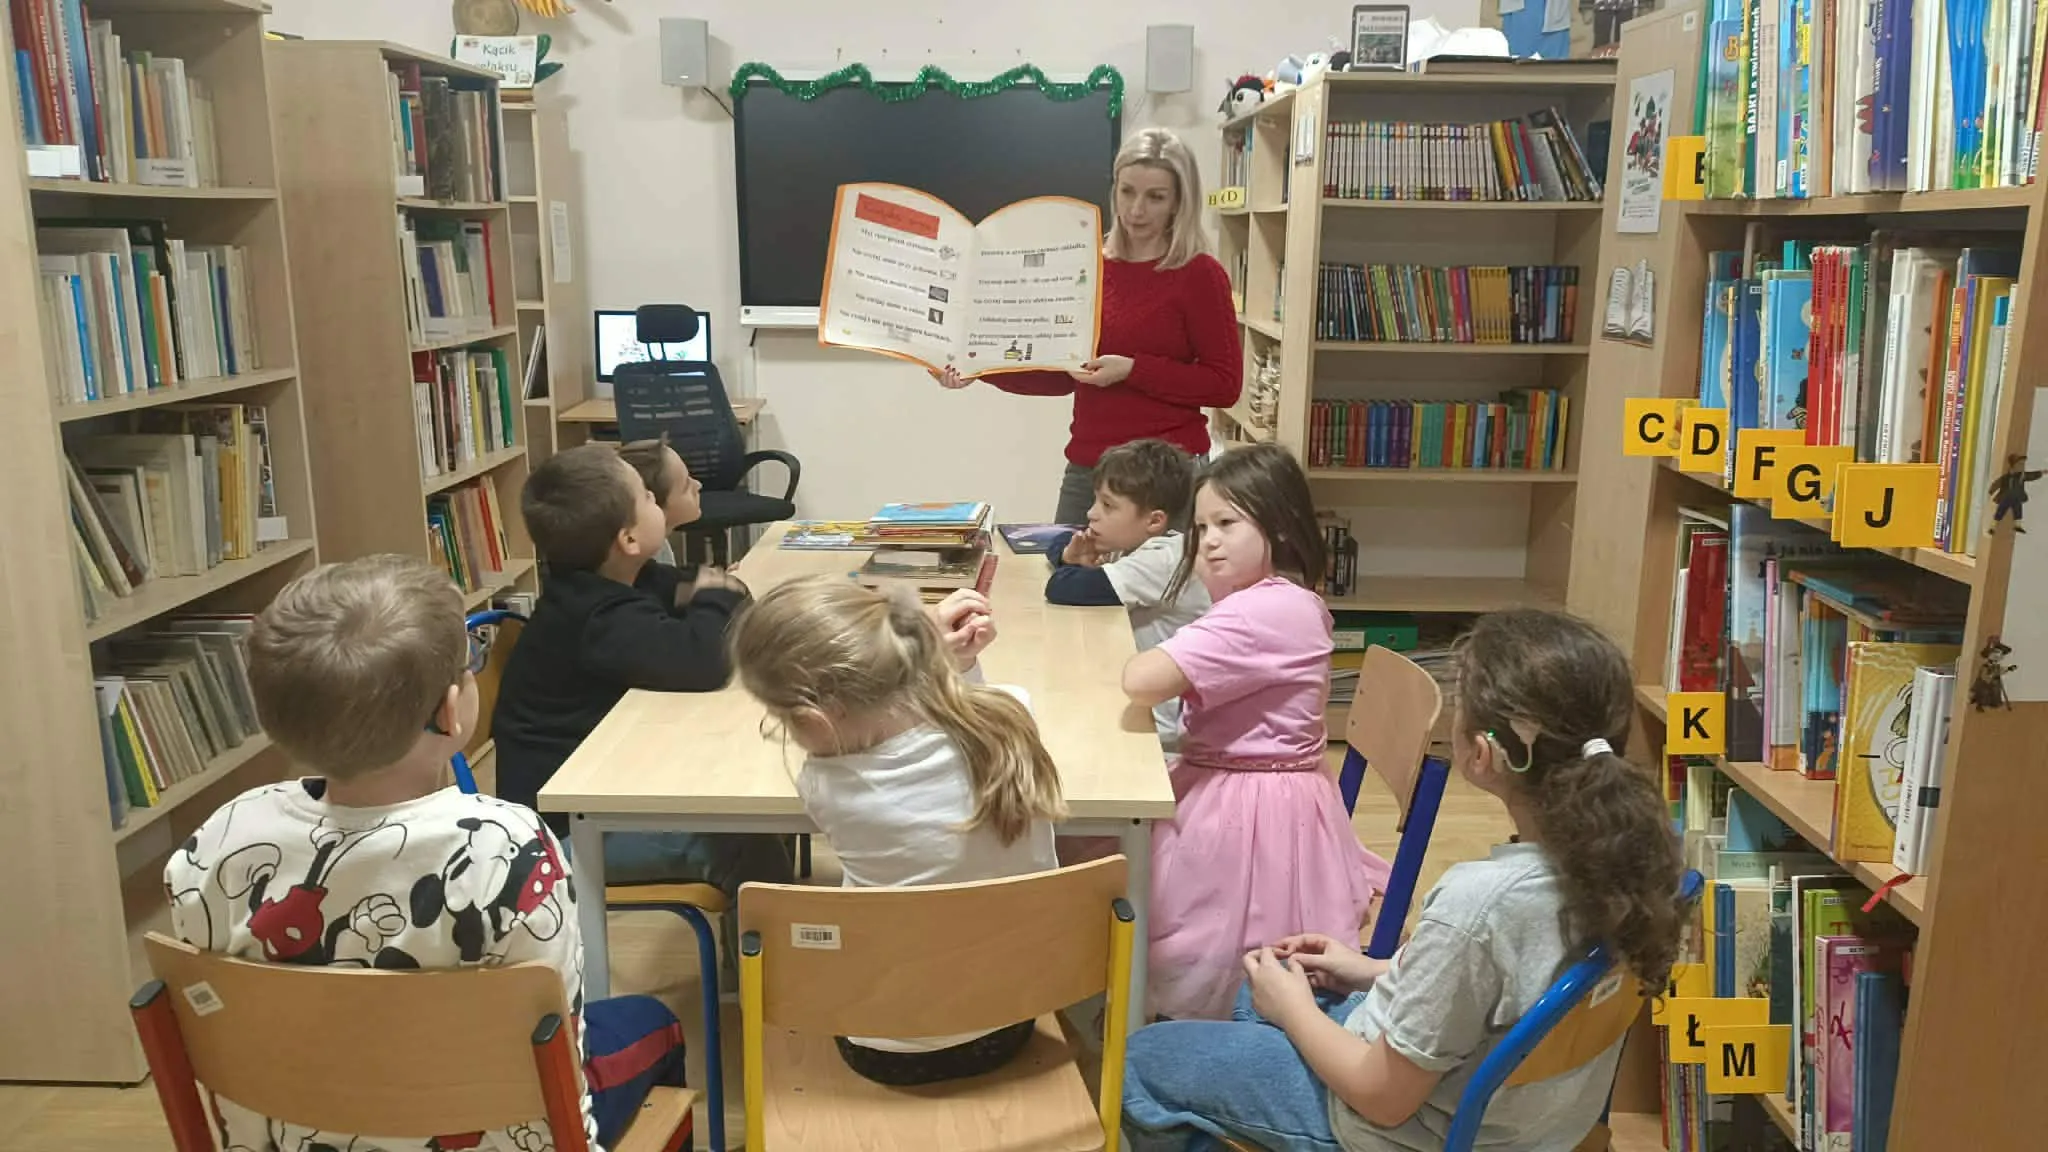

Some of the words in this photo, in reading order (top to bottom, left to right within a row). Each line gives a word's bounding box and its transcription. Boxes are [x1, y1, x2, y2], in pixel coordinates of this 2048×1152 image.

[483, 44, 516, 57] Kącik
[1747, 94, 1757, 134] BAJKI
[1227, 191, 1238, 201] D
[1639, 412, 1665, 443] C
[1692, 423, 1720, 456] D
[1753, 446, 1775, 481] F
[1787, 464, 1821, 502] G
[1864, 487, 1894, 528] J
[1683, 707, 1710, 739] K
[1686, 1014, 1705, 1047] Ł
[1722, 1042, 1756, 1077] M
